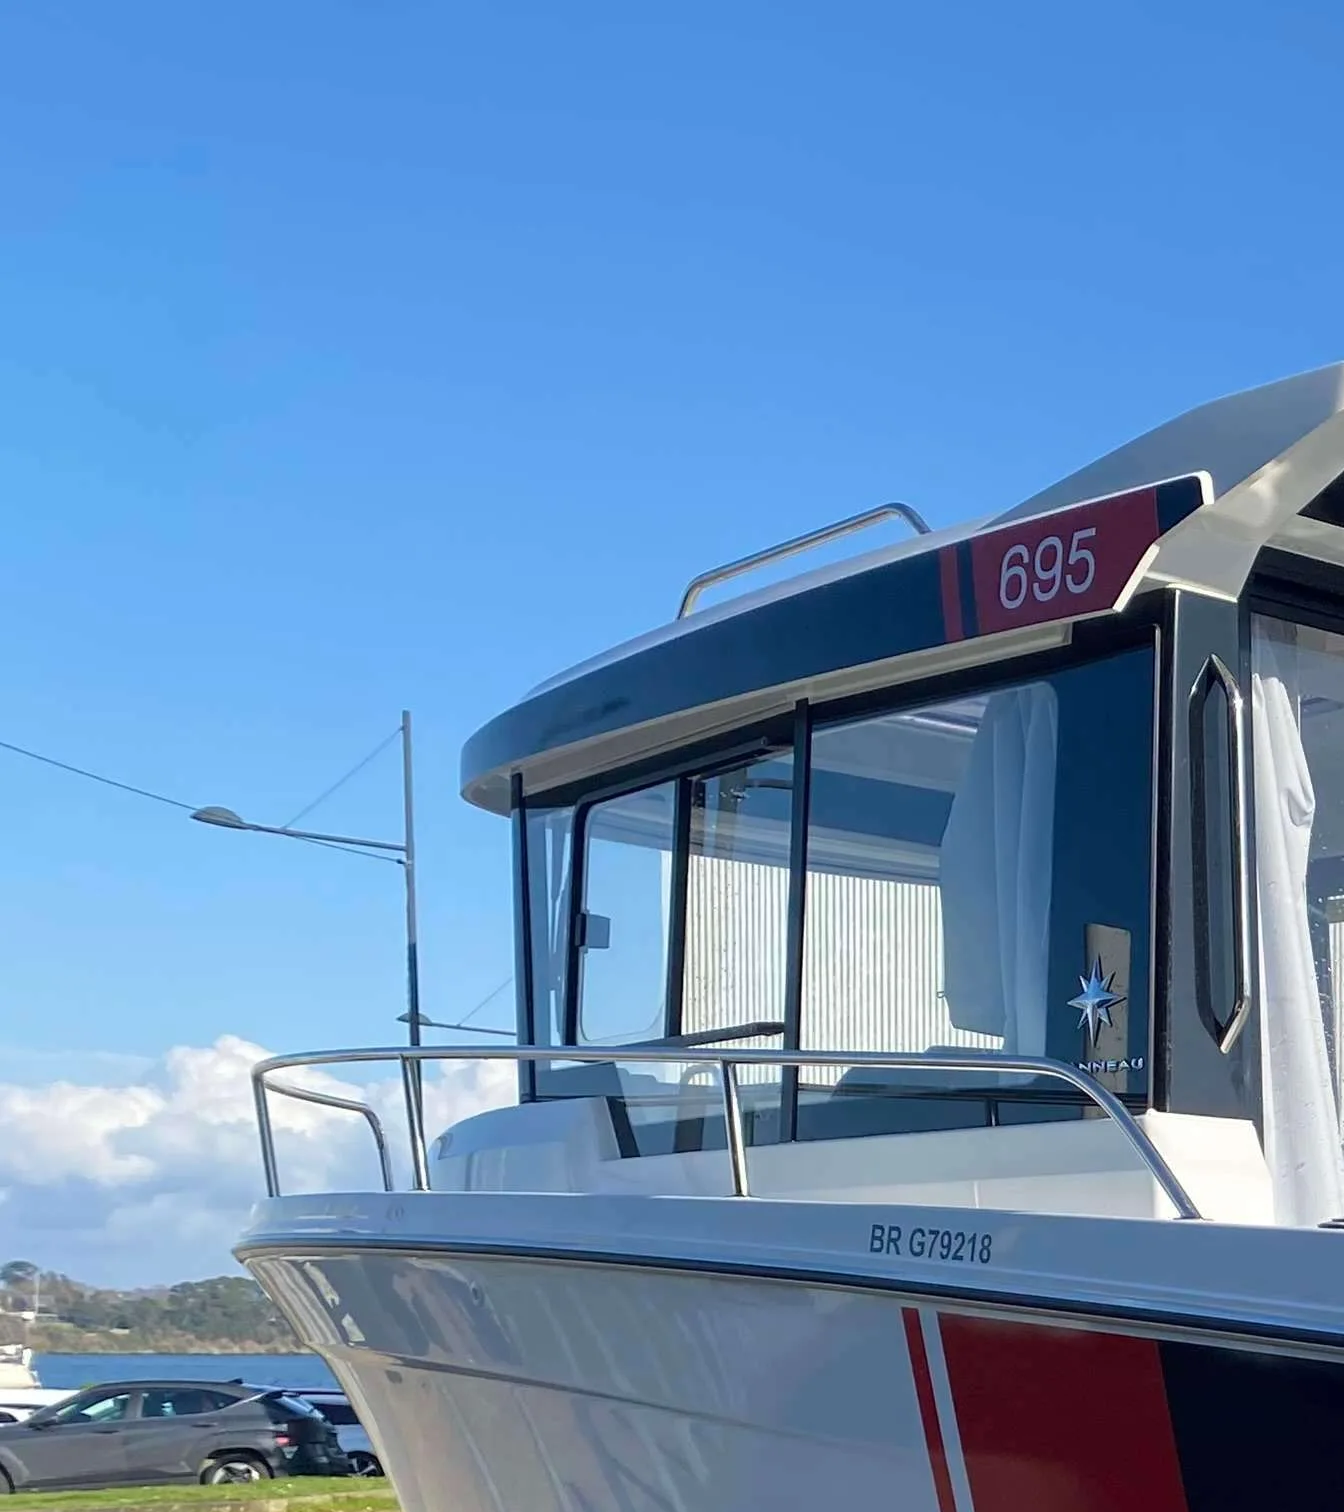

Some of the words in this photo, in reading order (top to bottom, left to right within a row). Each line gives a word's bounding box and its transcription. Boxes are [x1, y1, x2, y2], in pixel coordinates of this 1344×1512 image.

[1000, 527, 1096, 609] 695
[870, 1224, 901, 1255] BR
[909, 1228, 992, 1264] G79218
